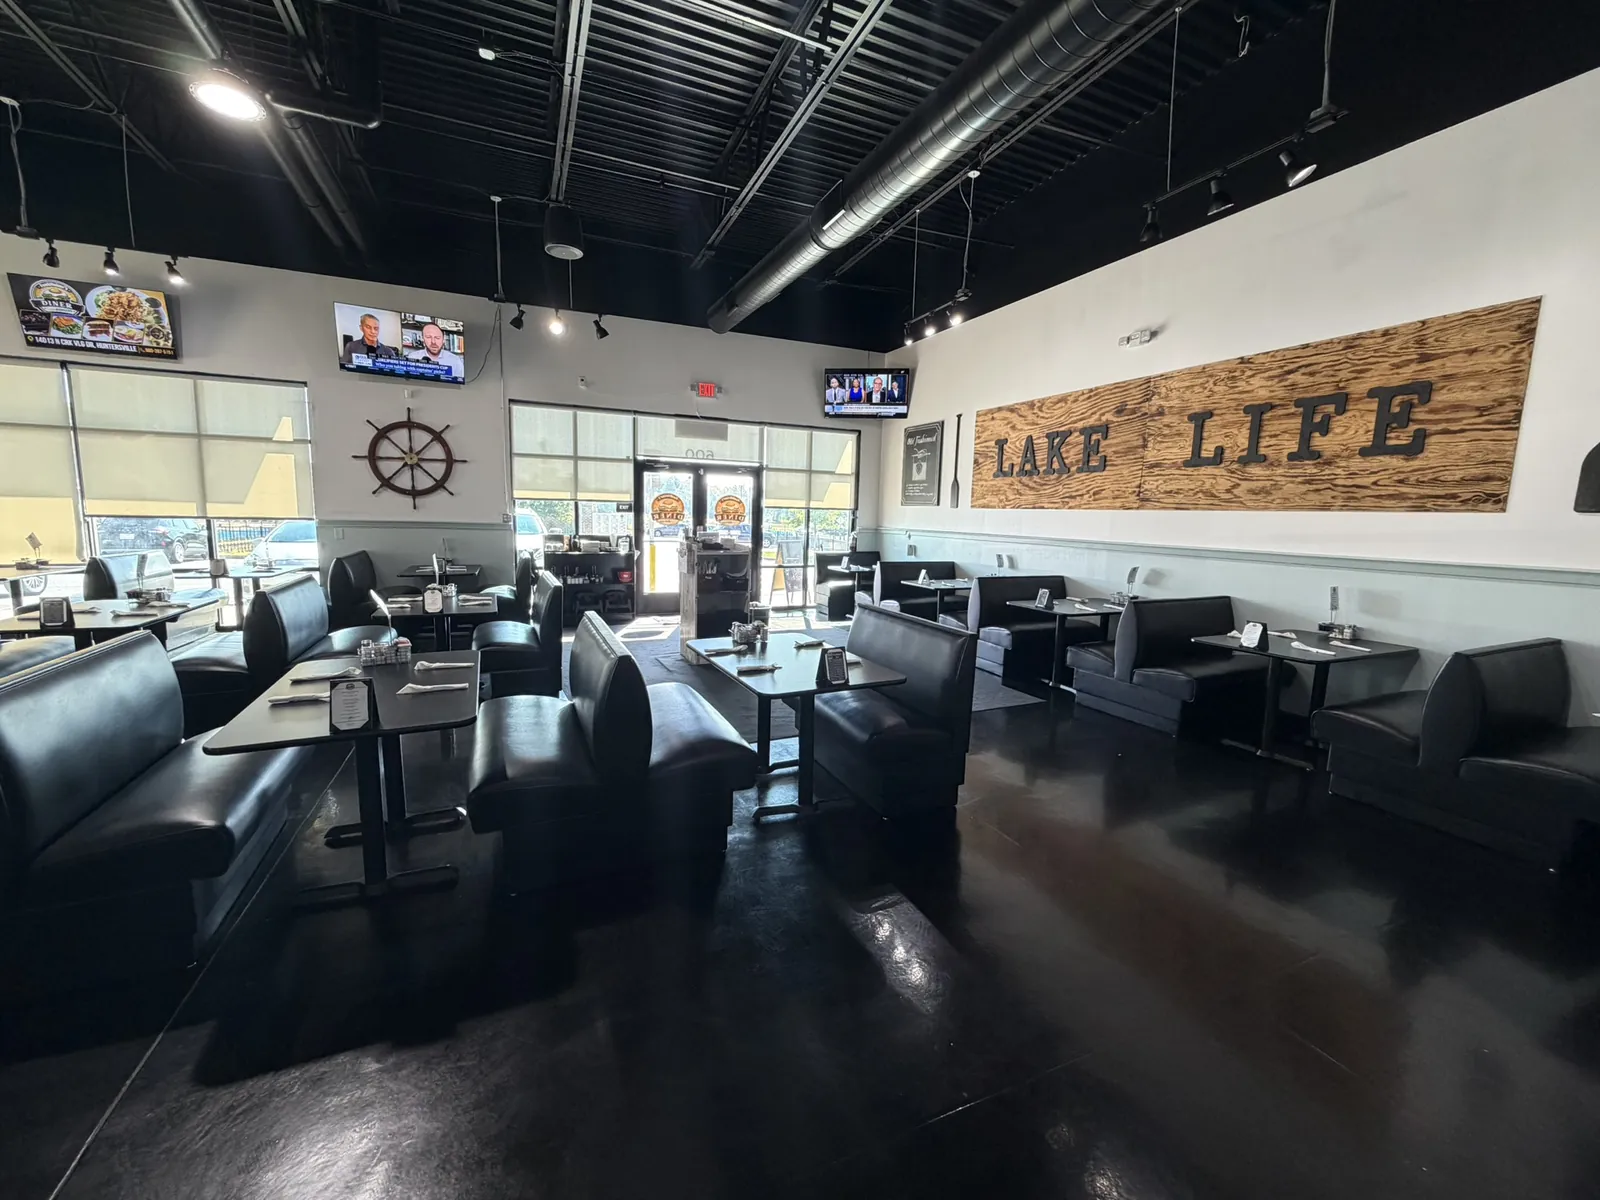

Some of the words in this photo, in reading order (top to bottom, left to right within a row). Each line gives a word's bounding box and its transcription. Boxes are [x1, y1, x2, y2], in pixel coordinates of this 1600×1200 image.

[41, 300, 73, 309] DINER
[73, 340, 85, 348] VLG
[96, 342, 137, 352] HUNTERSVILLE
[699, 383, 715, 397] EXIT
[992, 424, 1109, 478] LAKE
[1182, 380, 1433, 468] LIFE
